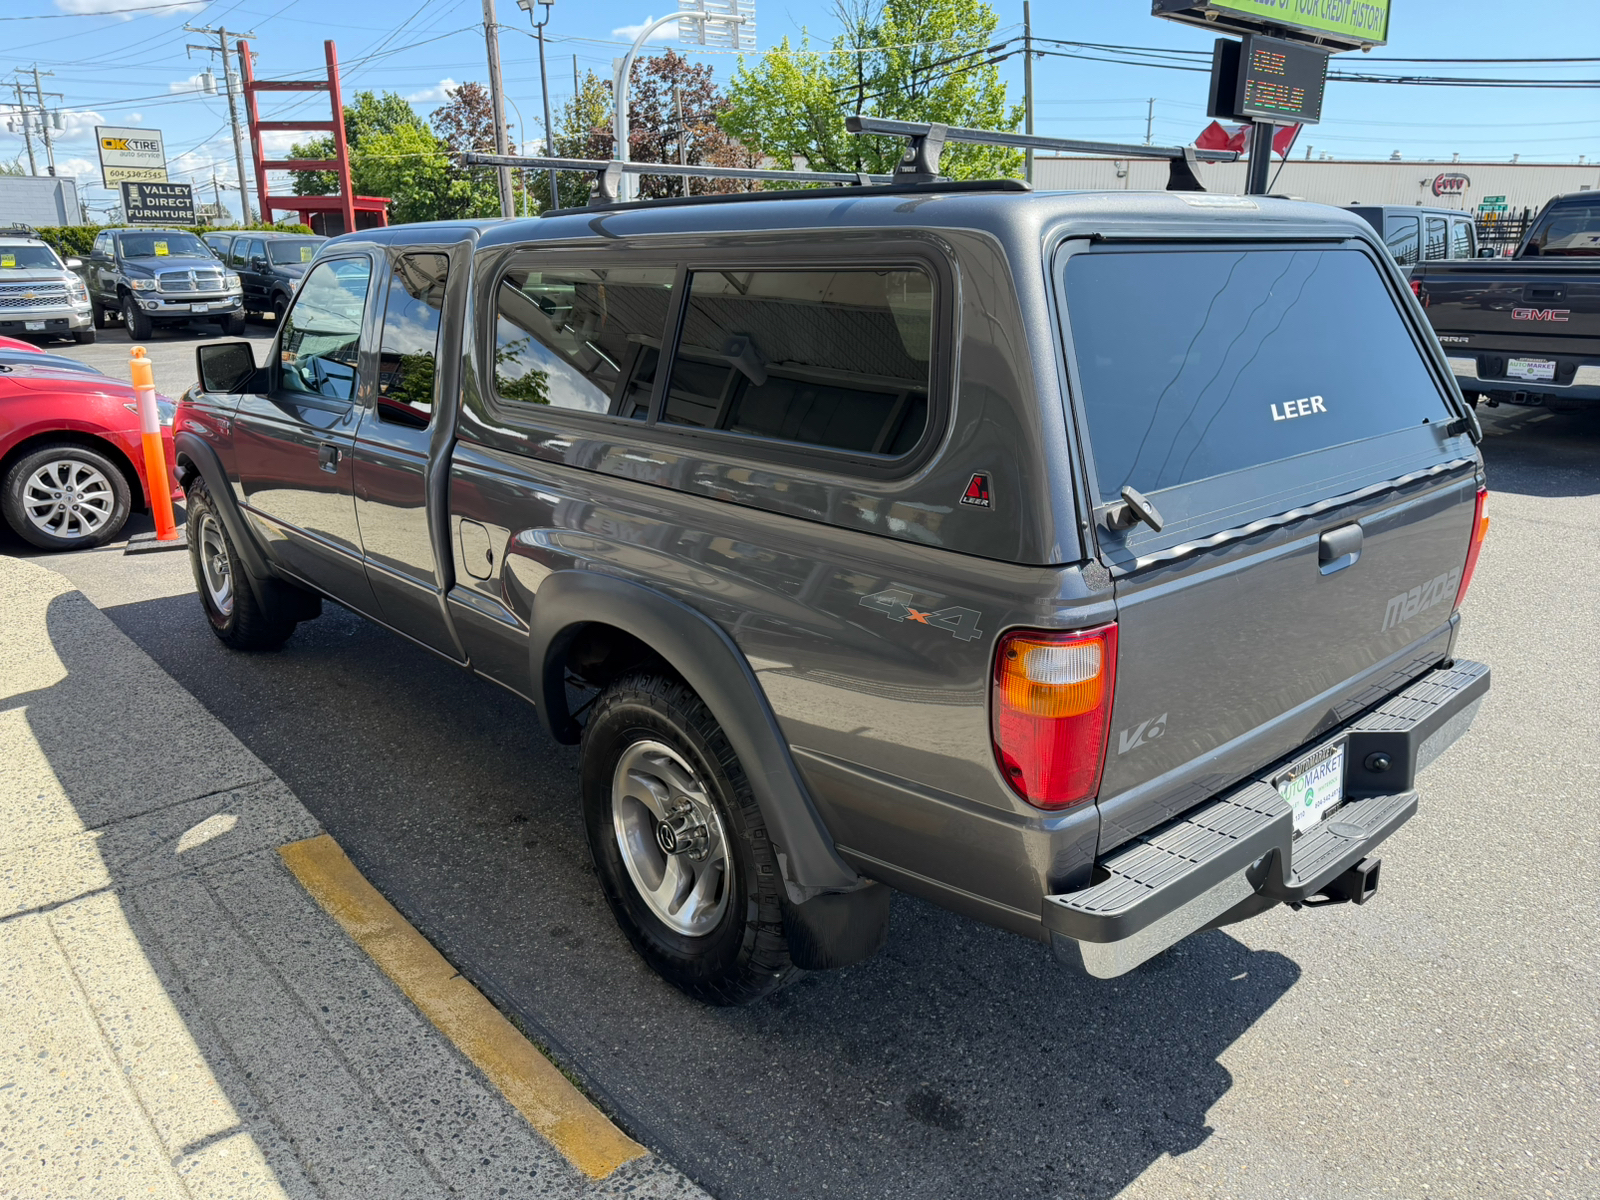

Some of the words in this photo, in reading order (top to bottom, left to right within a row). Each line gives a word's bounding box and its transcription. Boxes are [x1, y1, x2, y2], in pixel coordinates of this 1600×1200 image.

[1321, 0, 1350, 24] CREDIT
[1350, 1, 1385, 32] HISTORY
[101, 137, 130, 151] OK
[132, 140, 157, 150] TIRE
[110, 169, 162, 179] 604.530.2545
[142, 185, 190, 195] VALLEY
[146, 197, 191, 207] DIRECT
[127, 209, 194, 218] FURNITURE
[1512, 307, 1571, 322] GMC
[1509, 361, 1556, 370] AUTOMARKET
[1270, 395, 1327, 421] LEER
[963, 496, 989, 506] LEER
[859, 589, 983, 642] 4x4
[1118, 712, 1168, 755] V6
